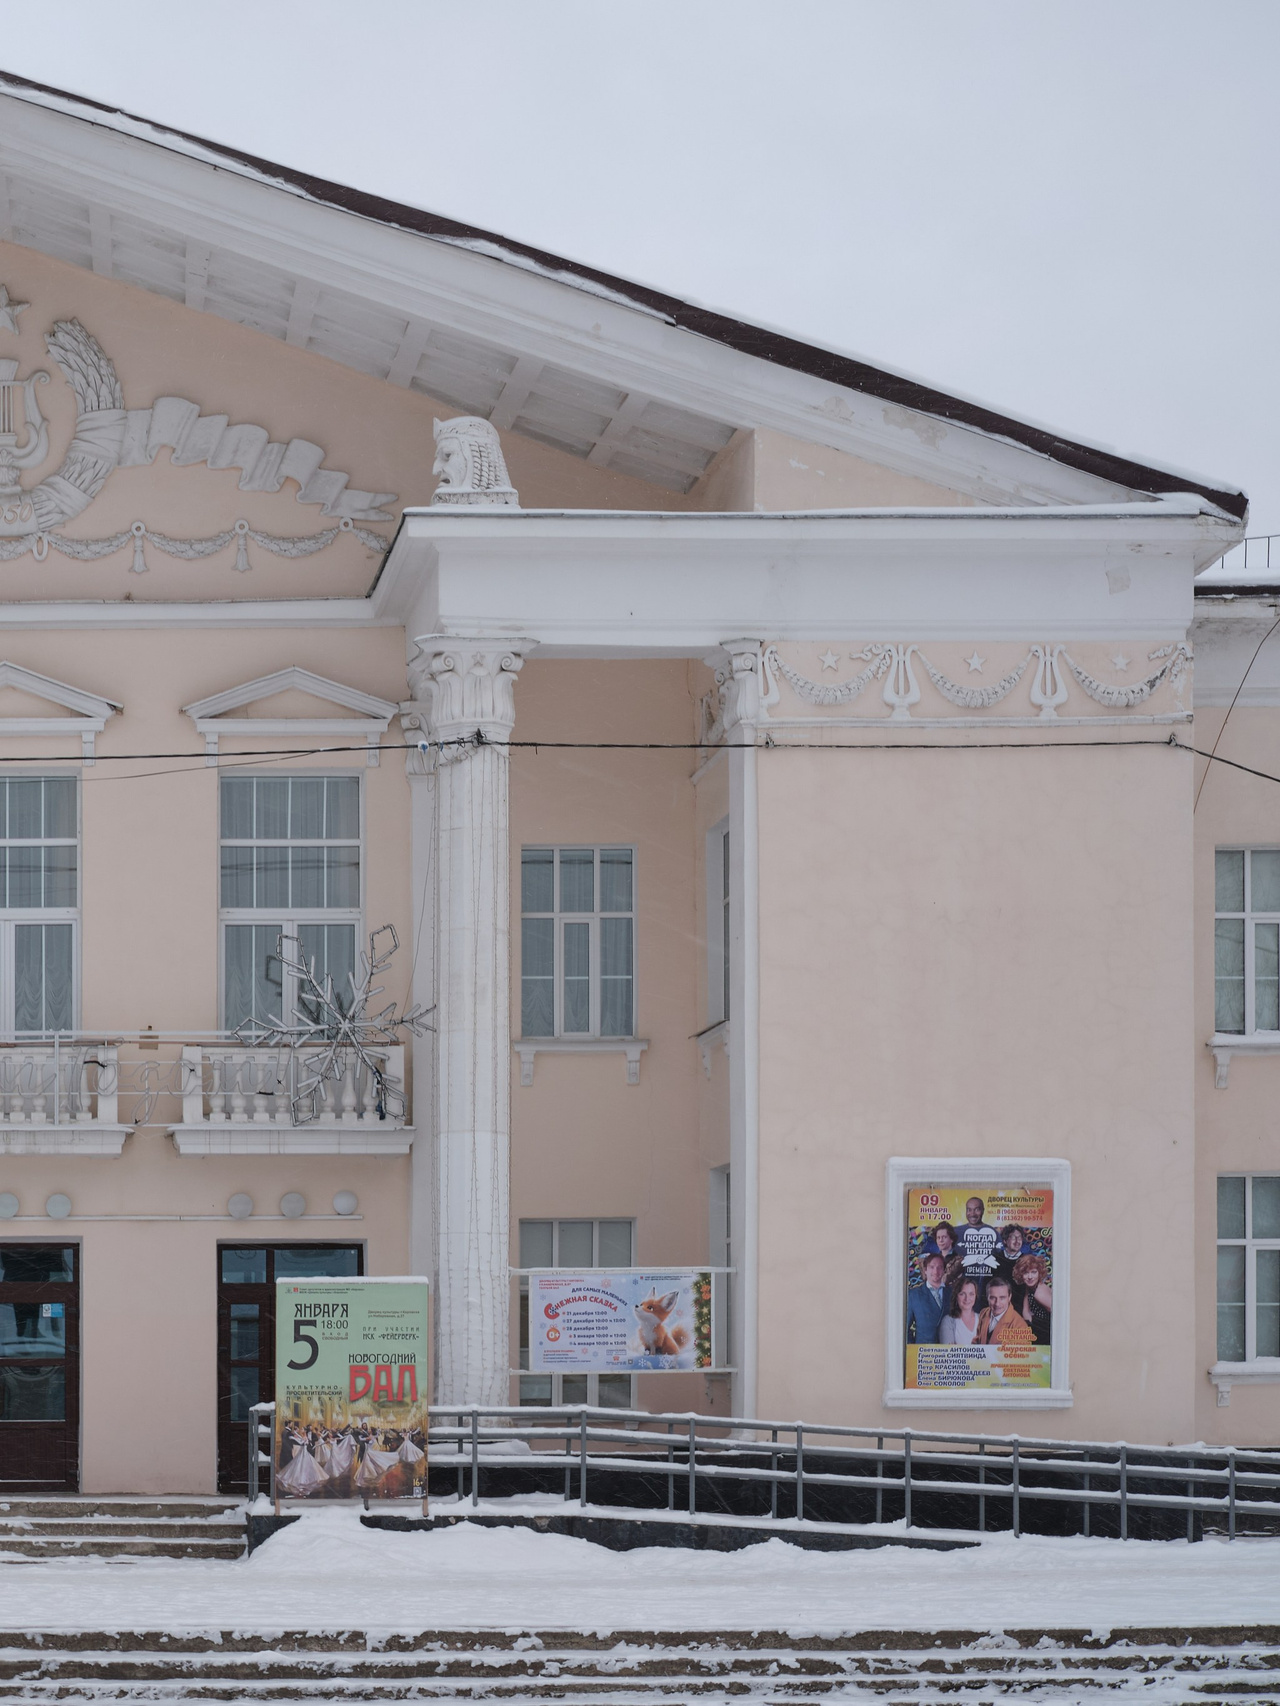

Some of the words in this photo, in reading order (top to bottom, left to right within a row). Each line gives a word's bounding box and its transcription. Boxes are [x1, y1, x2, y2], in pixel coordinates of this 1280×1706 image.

[920, 1195, 939, 1206] 09
[589, 1296, 618, 1312] СКАЗКА
[601, 1289, 628, 1306] МАЛЕНЬКИХ
[294, 1304, 348, 1317] ЯНВАРЯ
[321, 1320, 348, 1329] 18:00
[287, 1320, 319, 1370] 5
[348, 1352, 416, 1365] НОВОГОДНИЙ
[349, 1365, 418, 1402] БАЛ
[413, 1478, 423, 1486] 16+
